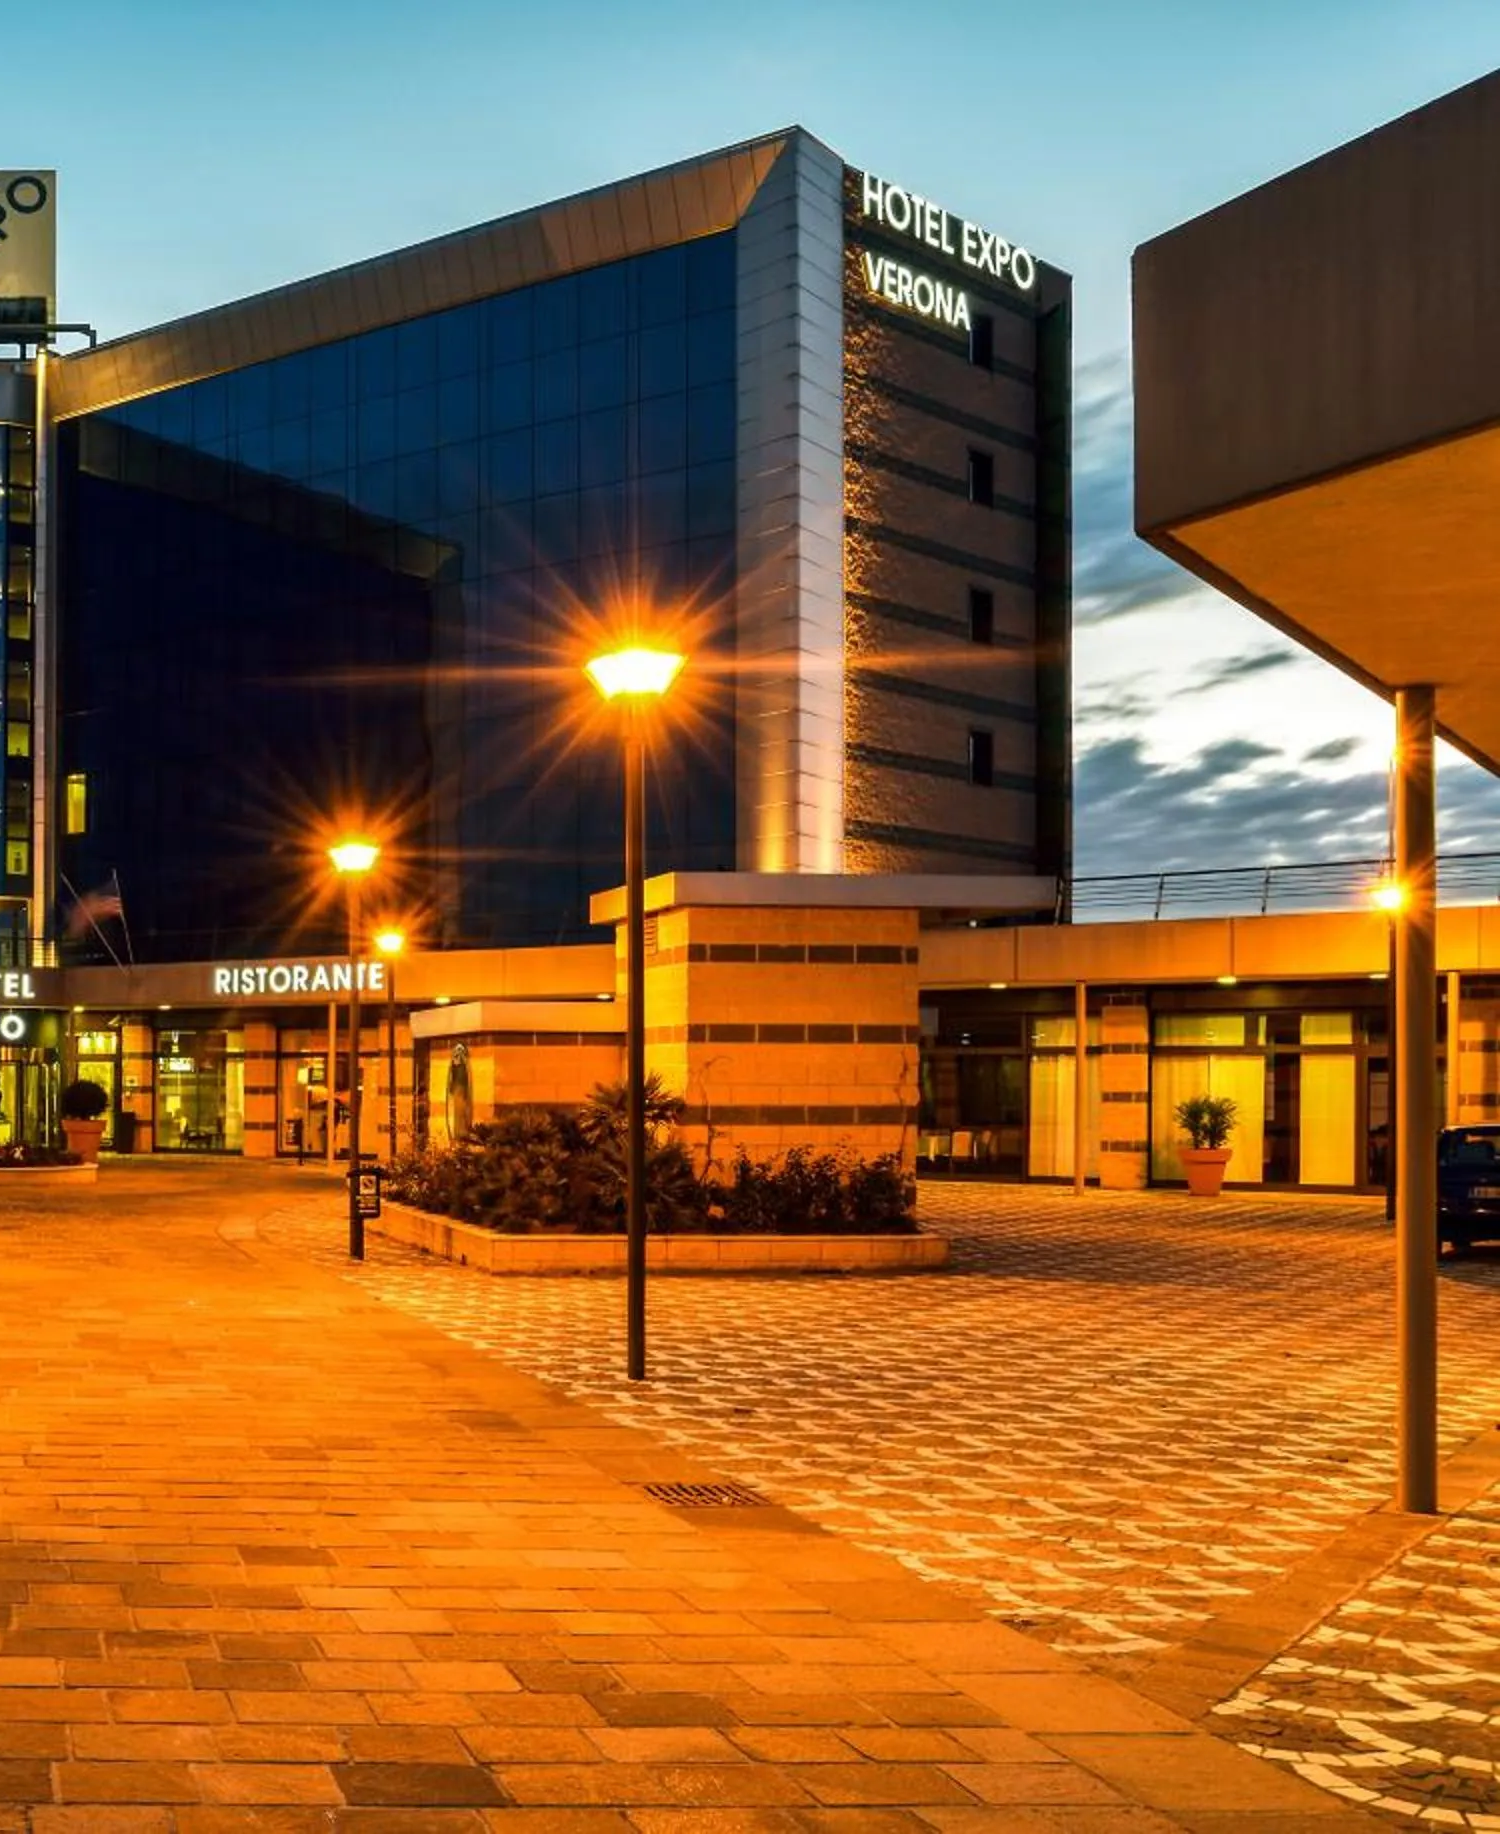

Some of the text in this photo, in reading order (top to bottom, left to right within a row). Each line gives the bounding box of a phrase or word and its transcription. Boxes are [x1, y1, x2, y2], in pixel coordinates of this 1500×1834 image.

[863, 171, 1035, 290] HOTEL EXPO
[863, 251, 971, 331] VERONA
[214, 962, 384, 995] RISTORANTE
